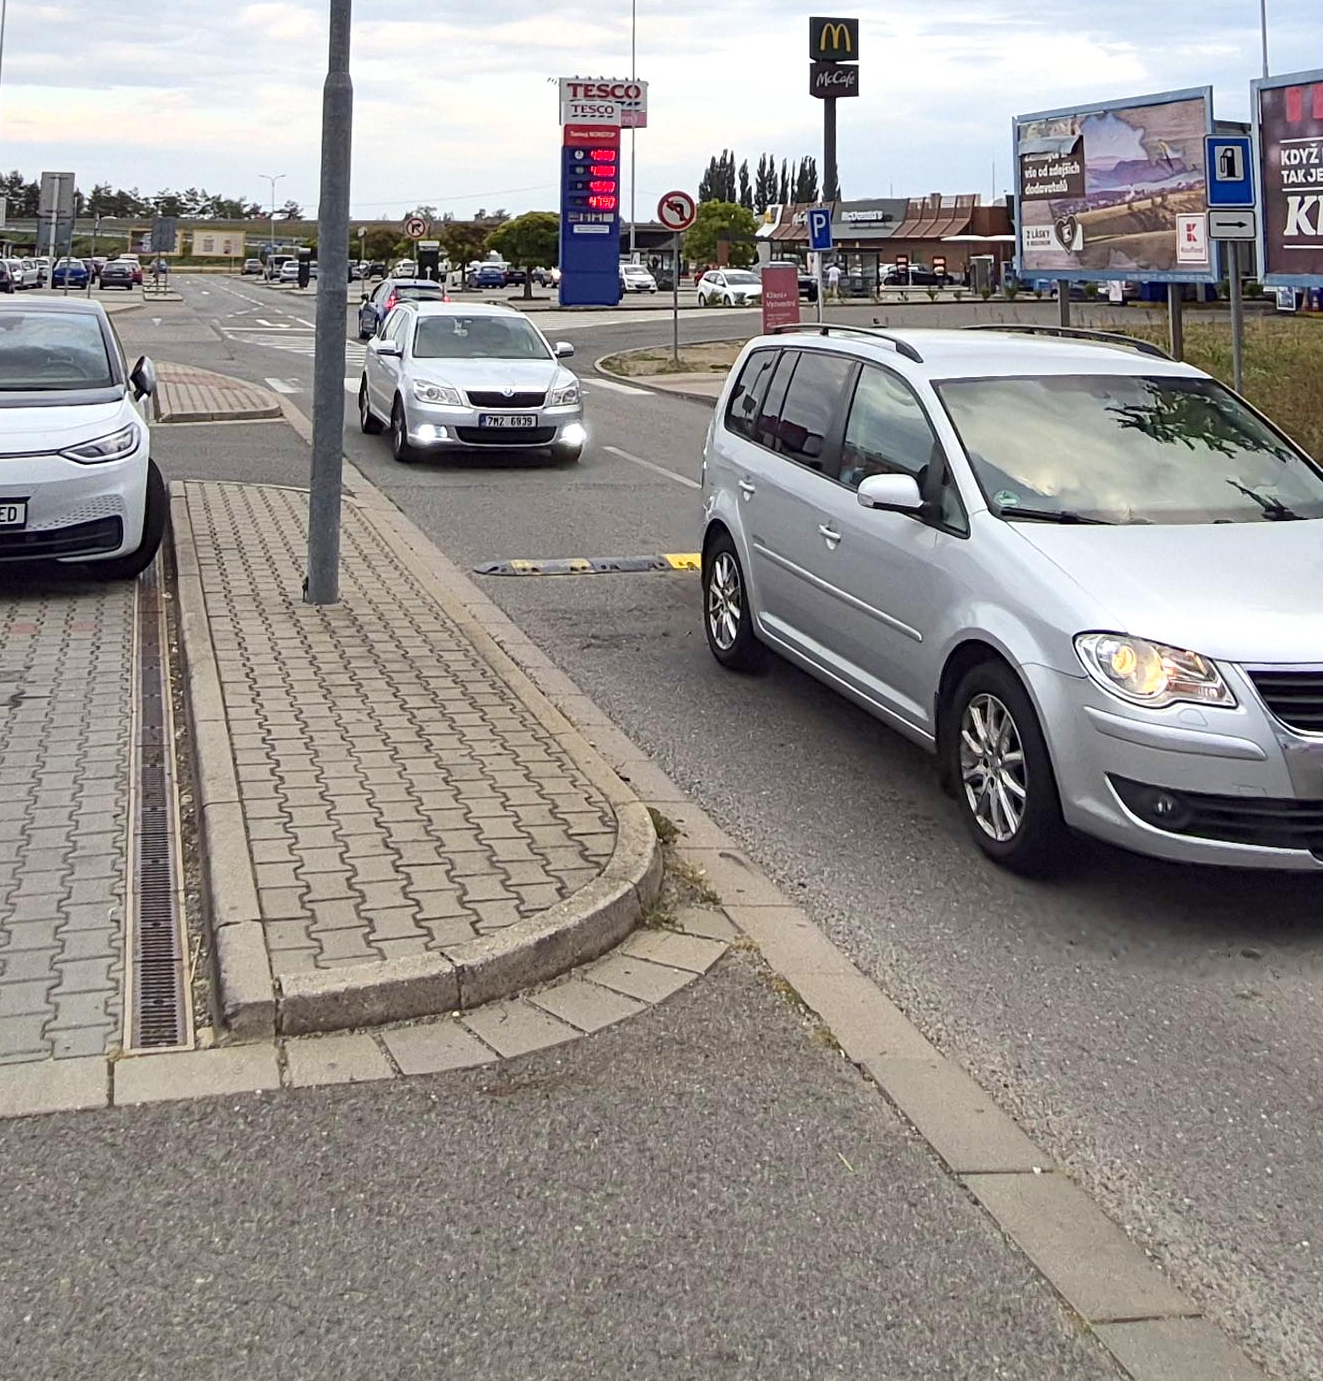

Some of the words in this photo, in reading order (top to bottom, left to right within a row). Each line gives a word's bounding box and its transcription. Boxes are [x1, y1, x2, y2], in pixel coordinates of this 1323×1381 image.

[816, 70, 855, 87] McCafé
[567, 82, 642, 100] TESCO
[570, 104, 615, 115] TESCO
[1281, 143, 1319, 166] KDYŽ
[1281, 169, 1306, 184] TAK
[813, 213, 826, 238] P
